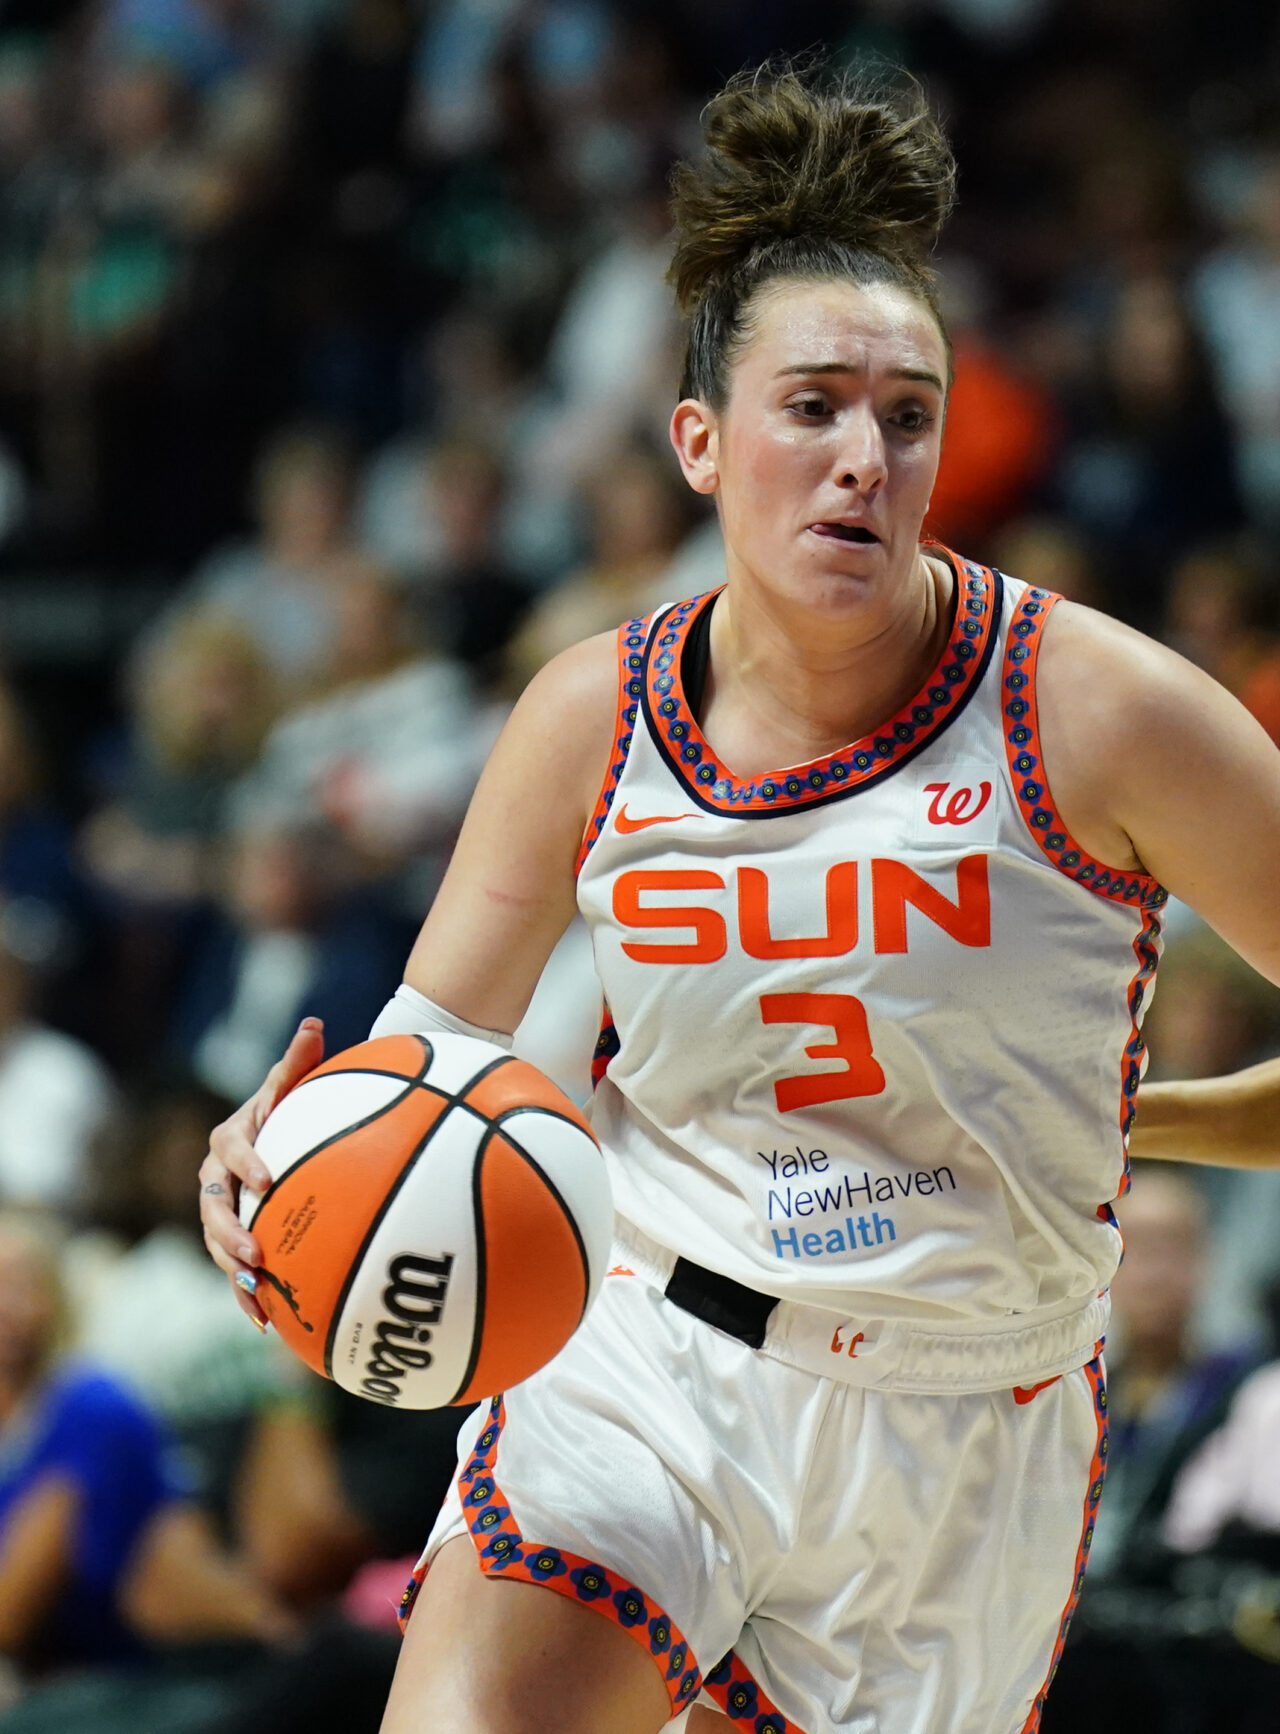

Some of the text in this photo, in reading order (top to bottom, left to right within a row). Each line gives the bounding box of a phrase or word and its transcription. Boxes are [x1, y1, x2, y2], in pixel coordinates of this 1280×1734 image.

[612, 854, 991, 965] SUN
[759, 992, 886, 1114] 3
[757, 1146, 830, 1181] Yale
[768, 1166, 957, 1220] NewHaven
[771, 1212, 897, 1259] Health
